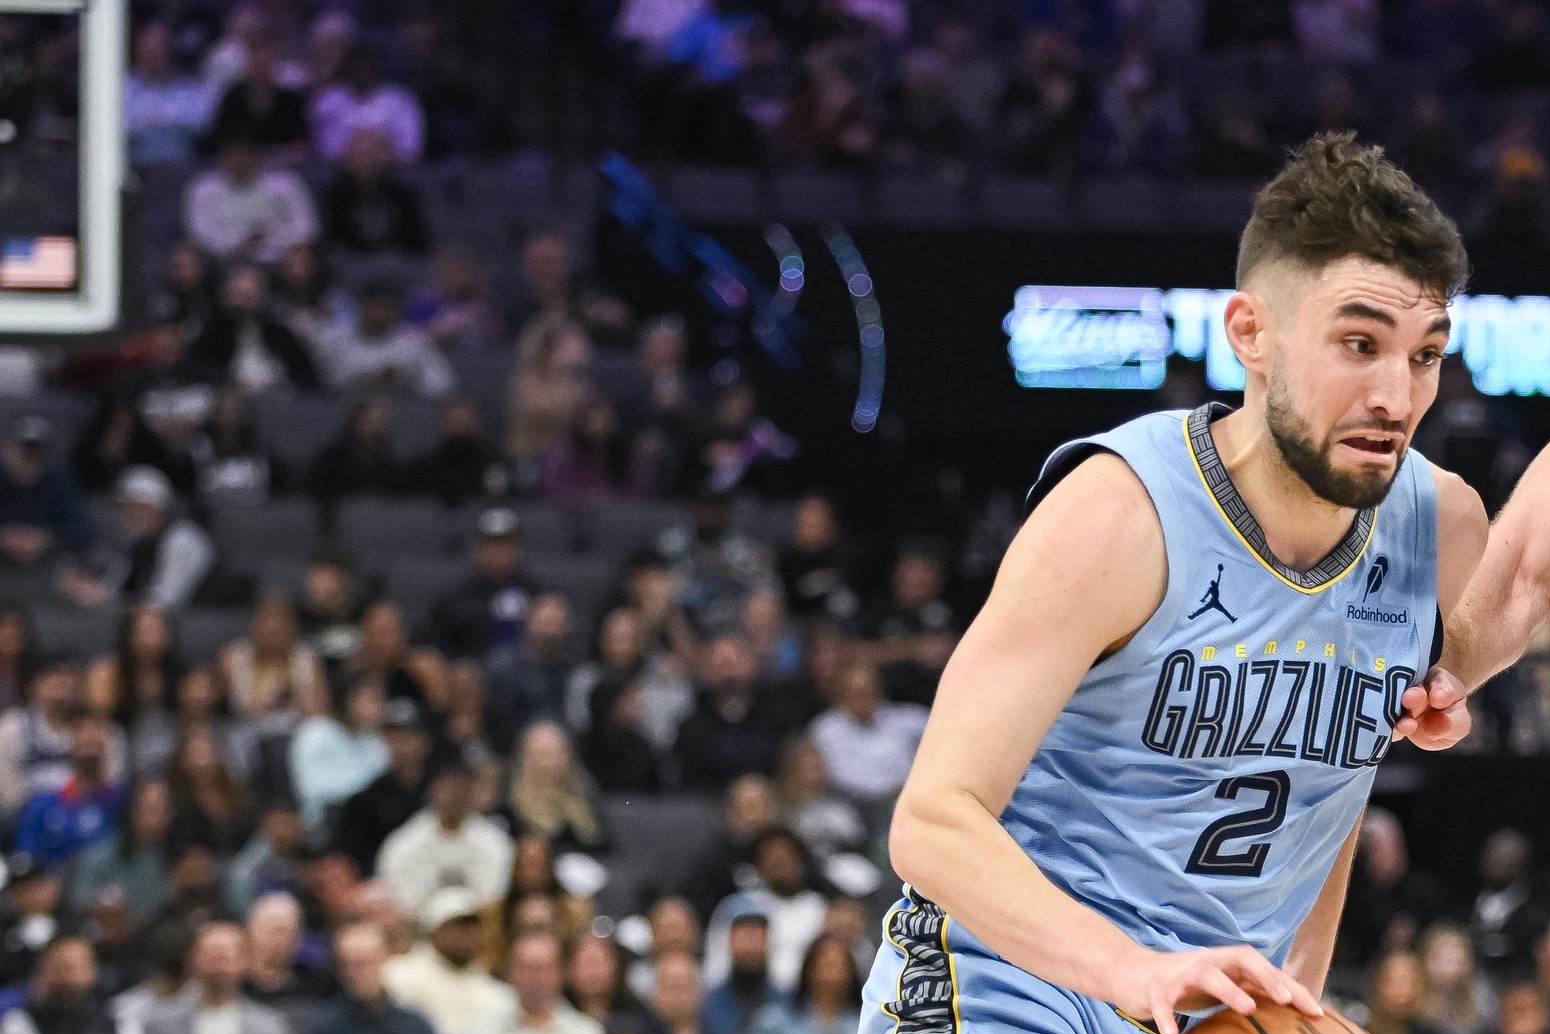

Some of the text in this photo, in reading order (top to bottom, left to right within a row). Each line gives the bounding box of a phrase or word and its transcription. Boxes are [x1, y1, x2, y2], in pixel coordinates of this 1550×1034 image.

[1347, 605, 1407, 623] Robinhood
[1201, 640, 1386, 672] MEMPHIS
[1142, 649, 1416, 769] GRIZZLIES
[1184, 769, 1290, 877] 2
